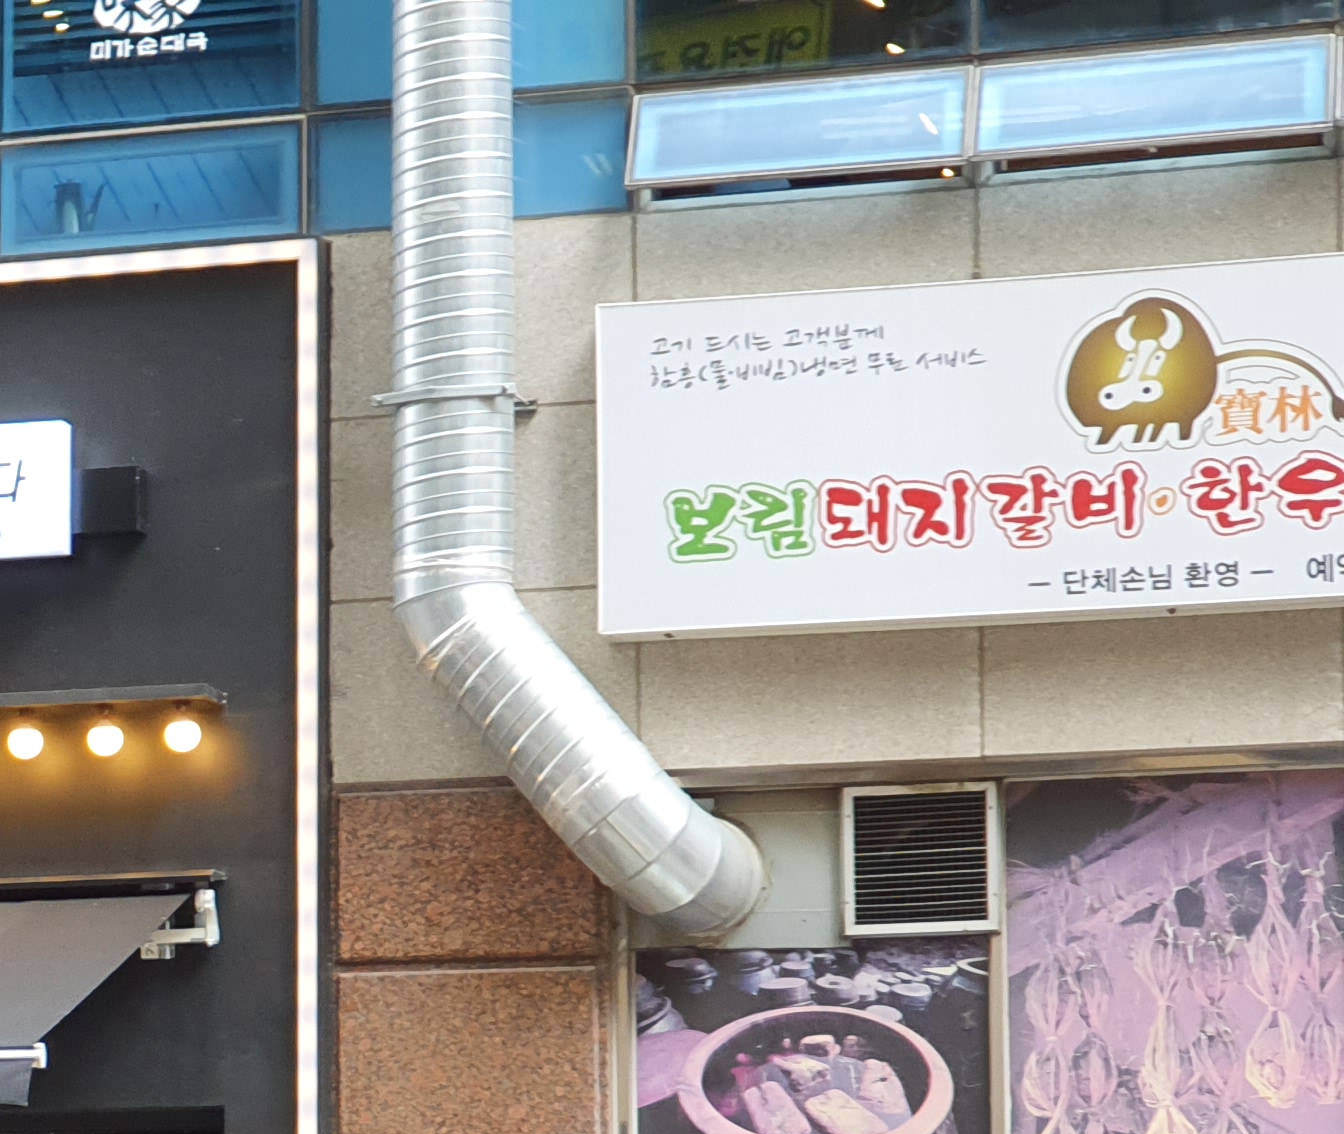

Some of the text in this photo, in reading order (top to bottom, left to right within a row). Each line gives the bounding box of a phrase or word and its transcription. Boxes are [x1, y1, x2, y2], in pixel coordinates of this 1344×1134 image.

[89, 31, 209, 61] 미가순대국
[650, 323, 885, 357] 고기 드시는 고객분께
[915, 348, 988, 370] 서비스
[1214, 384, 1324, 437] 寶林
[1063, 563, 1173, 596] 단체손님
[1183, 560, 1241, 588] 환영
